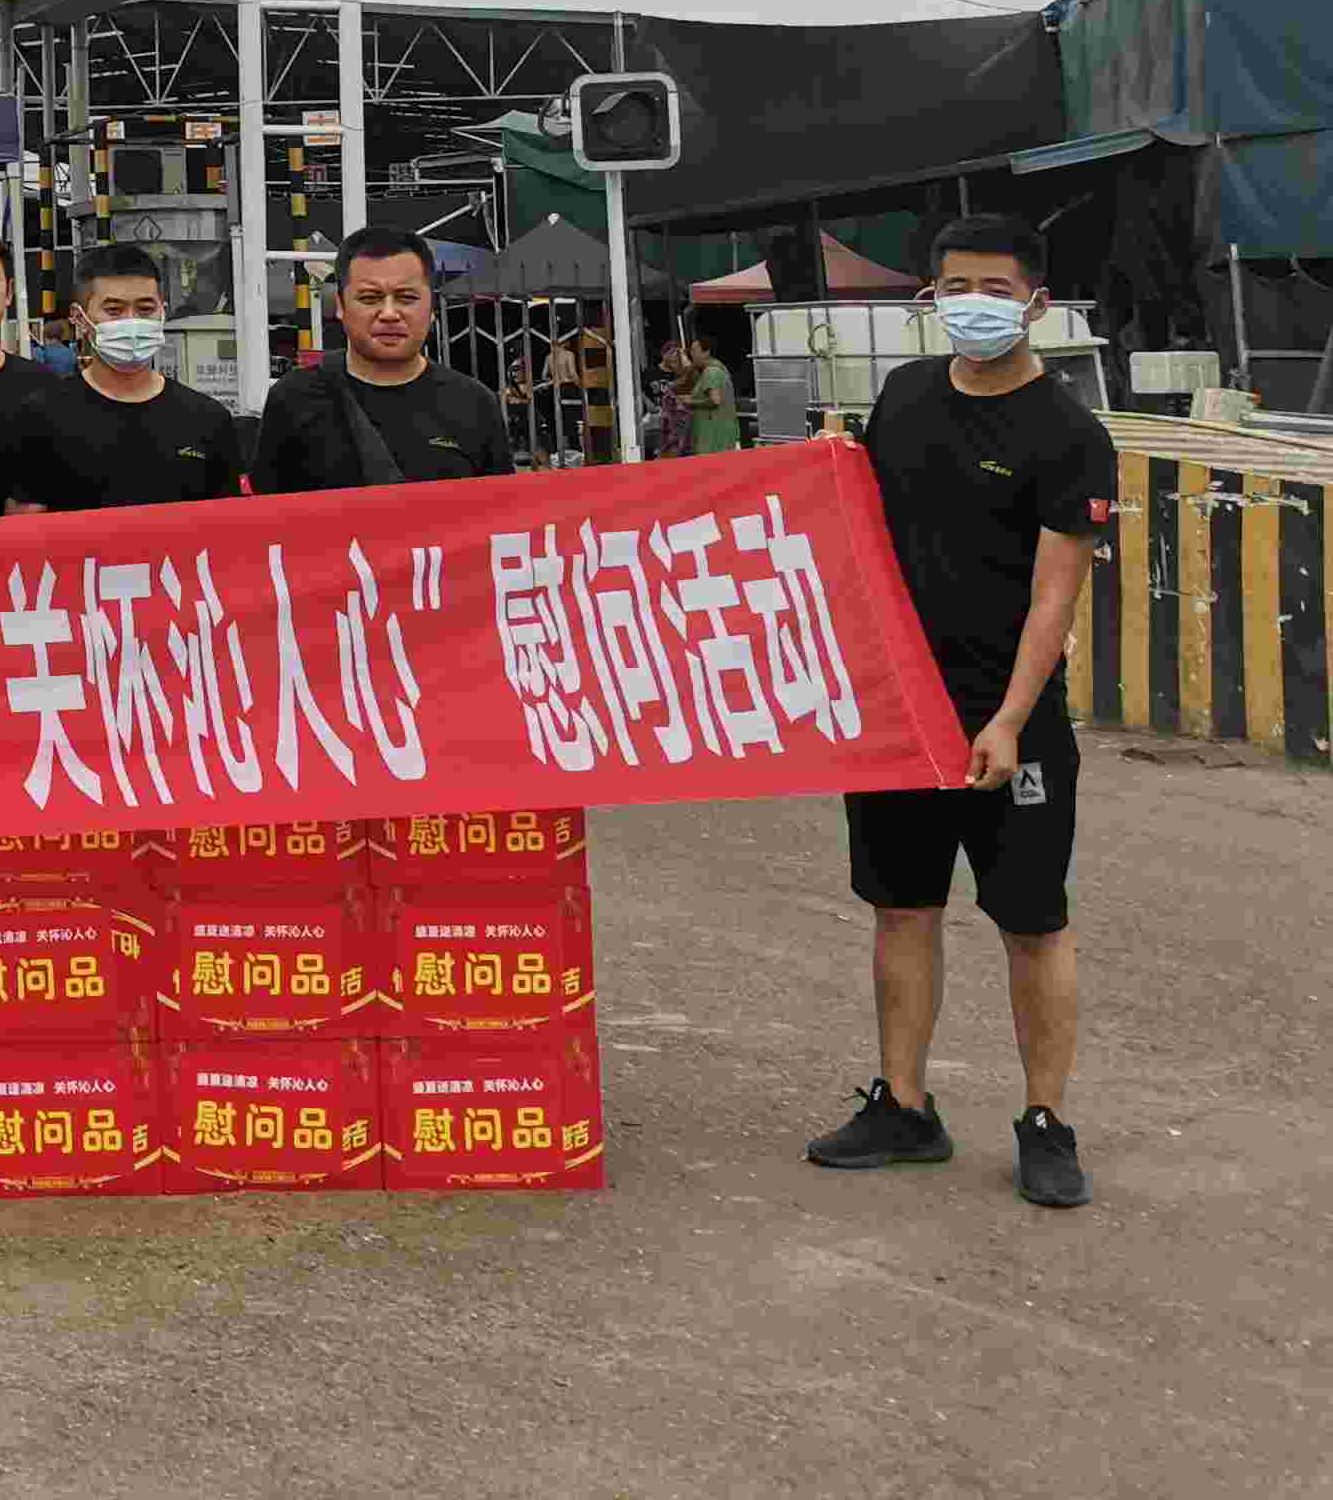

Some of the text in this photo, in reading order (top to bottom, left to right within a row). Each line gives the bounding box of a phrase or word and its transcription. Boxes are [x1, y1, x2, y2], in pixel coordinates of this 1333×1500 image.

[188, 826, 325, 857] 慰问品
[408, 812, 544, 854] 慰问品
[36, 927, 97, 942] 关怀沁人心
[264, 924, 325, 938] 关怀沁人心
[484, 924, 546, 938] 关怀沁人心
[191, 951, 330, 996] 慰问品
[414, 951, 551, 996] 慰问品
[52, 1079, 116, 1094] 关怀沁人心
[268, 1076, 328, 1092] 关怀沁人心
[484, 1077, 544, 1093] 关怀沁人心
[194, 1100, 333, 1150] 慰问品
[412, 1107, 552, 1153] 慰问品
